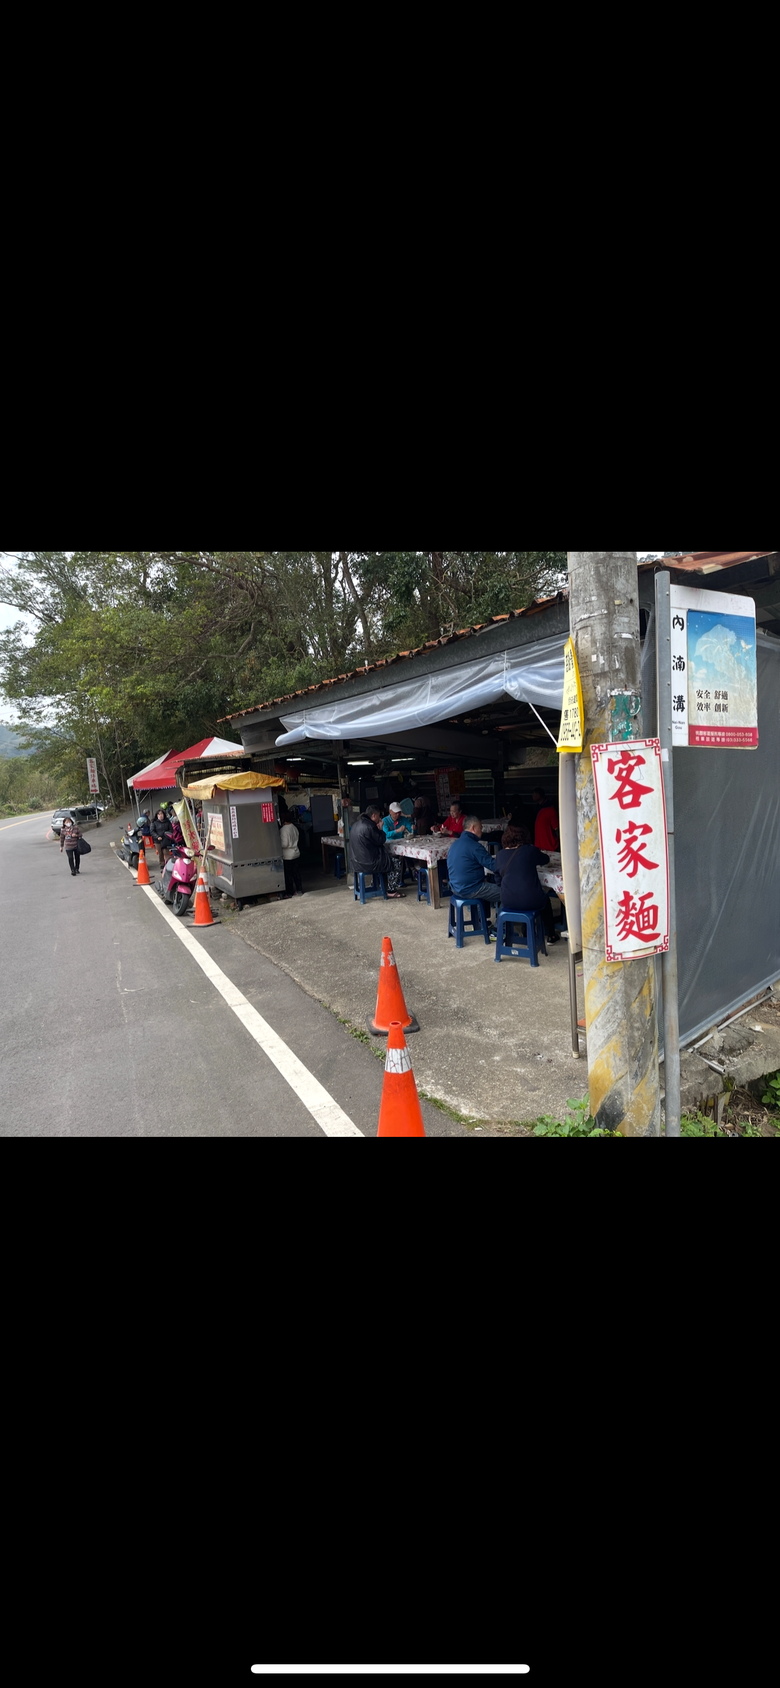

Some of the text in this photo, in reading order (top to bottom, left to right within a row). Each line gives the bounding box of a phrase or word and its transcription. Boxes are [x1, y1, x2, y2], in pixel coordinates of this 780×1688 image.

[672, 614, 686, 712] 內湳溝
[696, 689, 729, 701] 安全 舒適
[696, 702, 729, 713] 效率 創新
[607, 750, 661, 943] 客家麵
